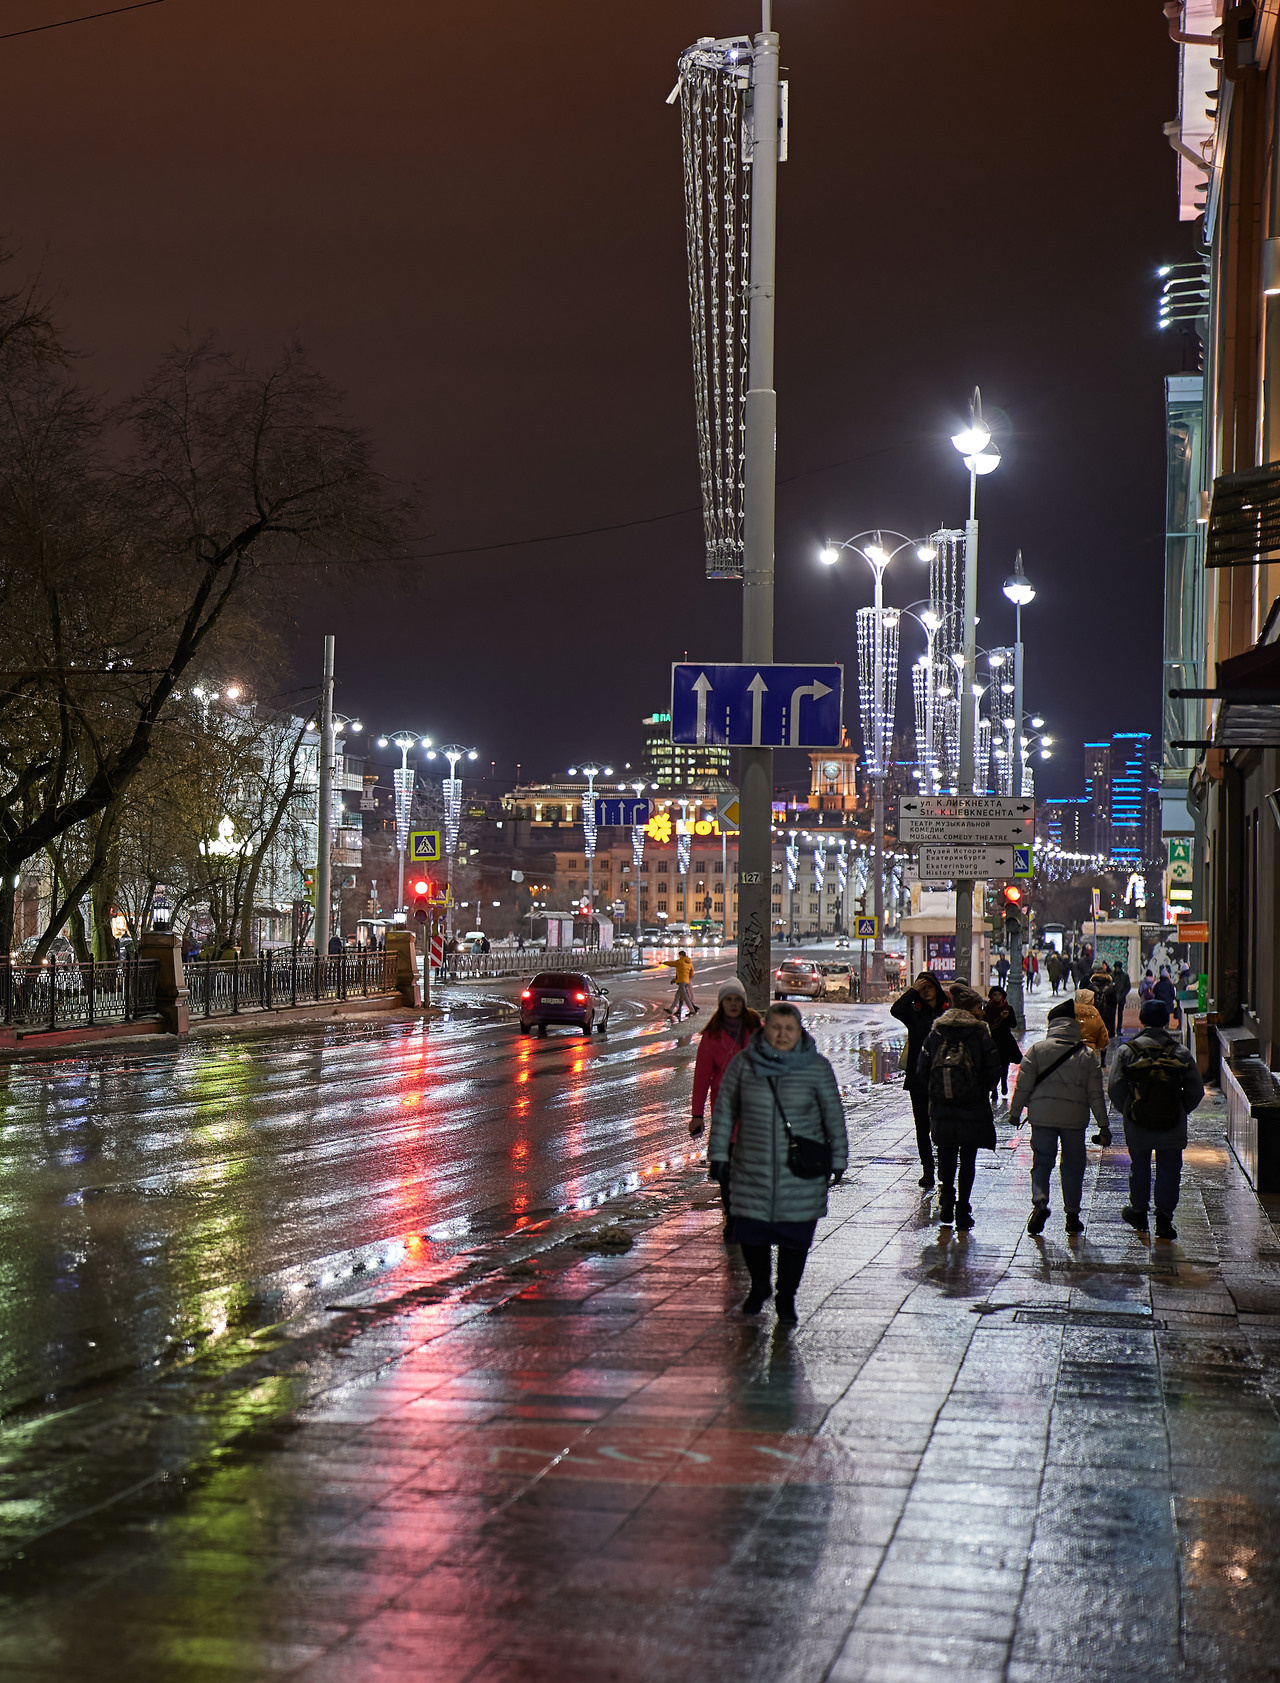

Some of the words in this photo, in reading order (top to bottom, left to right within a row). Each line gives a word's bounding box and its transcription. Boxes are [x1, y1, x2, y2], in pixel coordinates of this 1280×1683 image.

[940, 809, 1014, 817] K.LIEBKNECHTA
[935, 820, 991, 828] МУЗЫКАЛЬНОЙ
[926, 854, 986, 862] Екатеринбурга
[744, 874, 760, 883] 127
